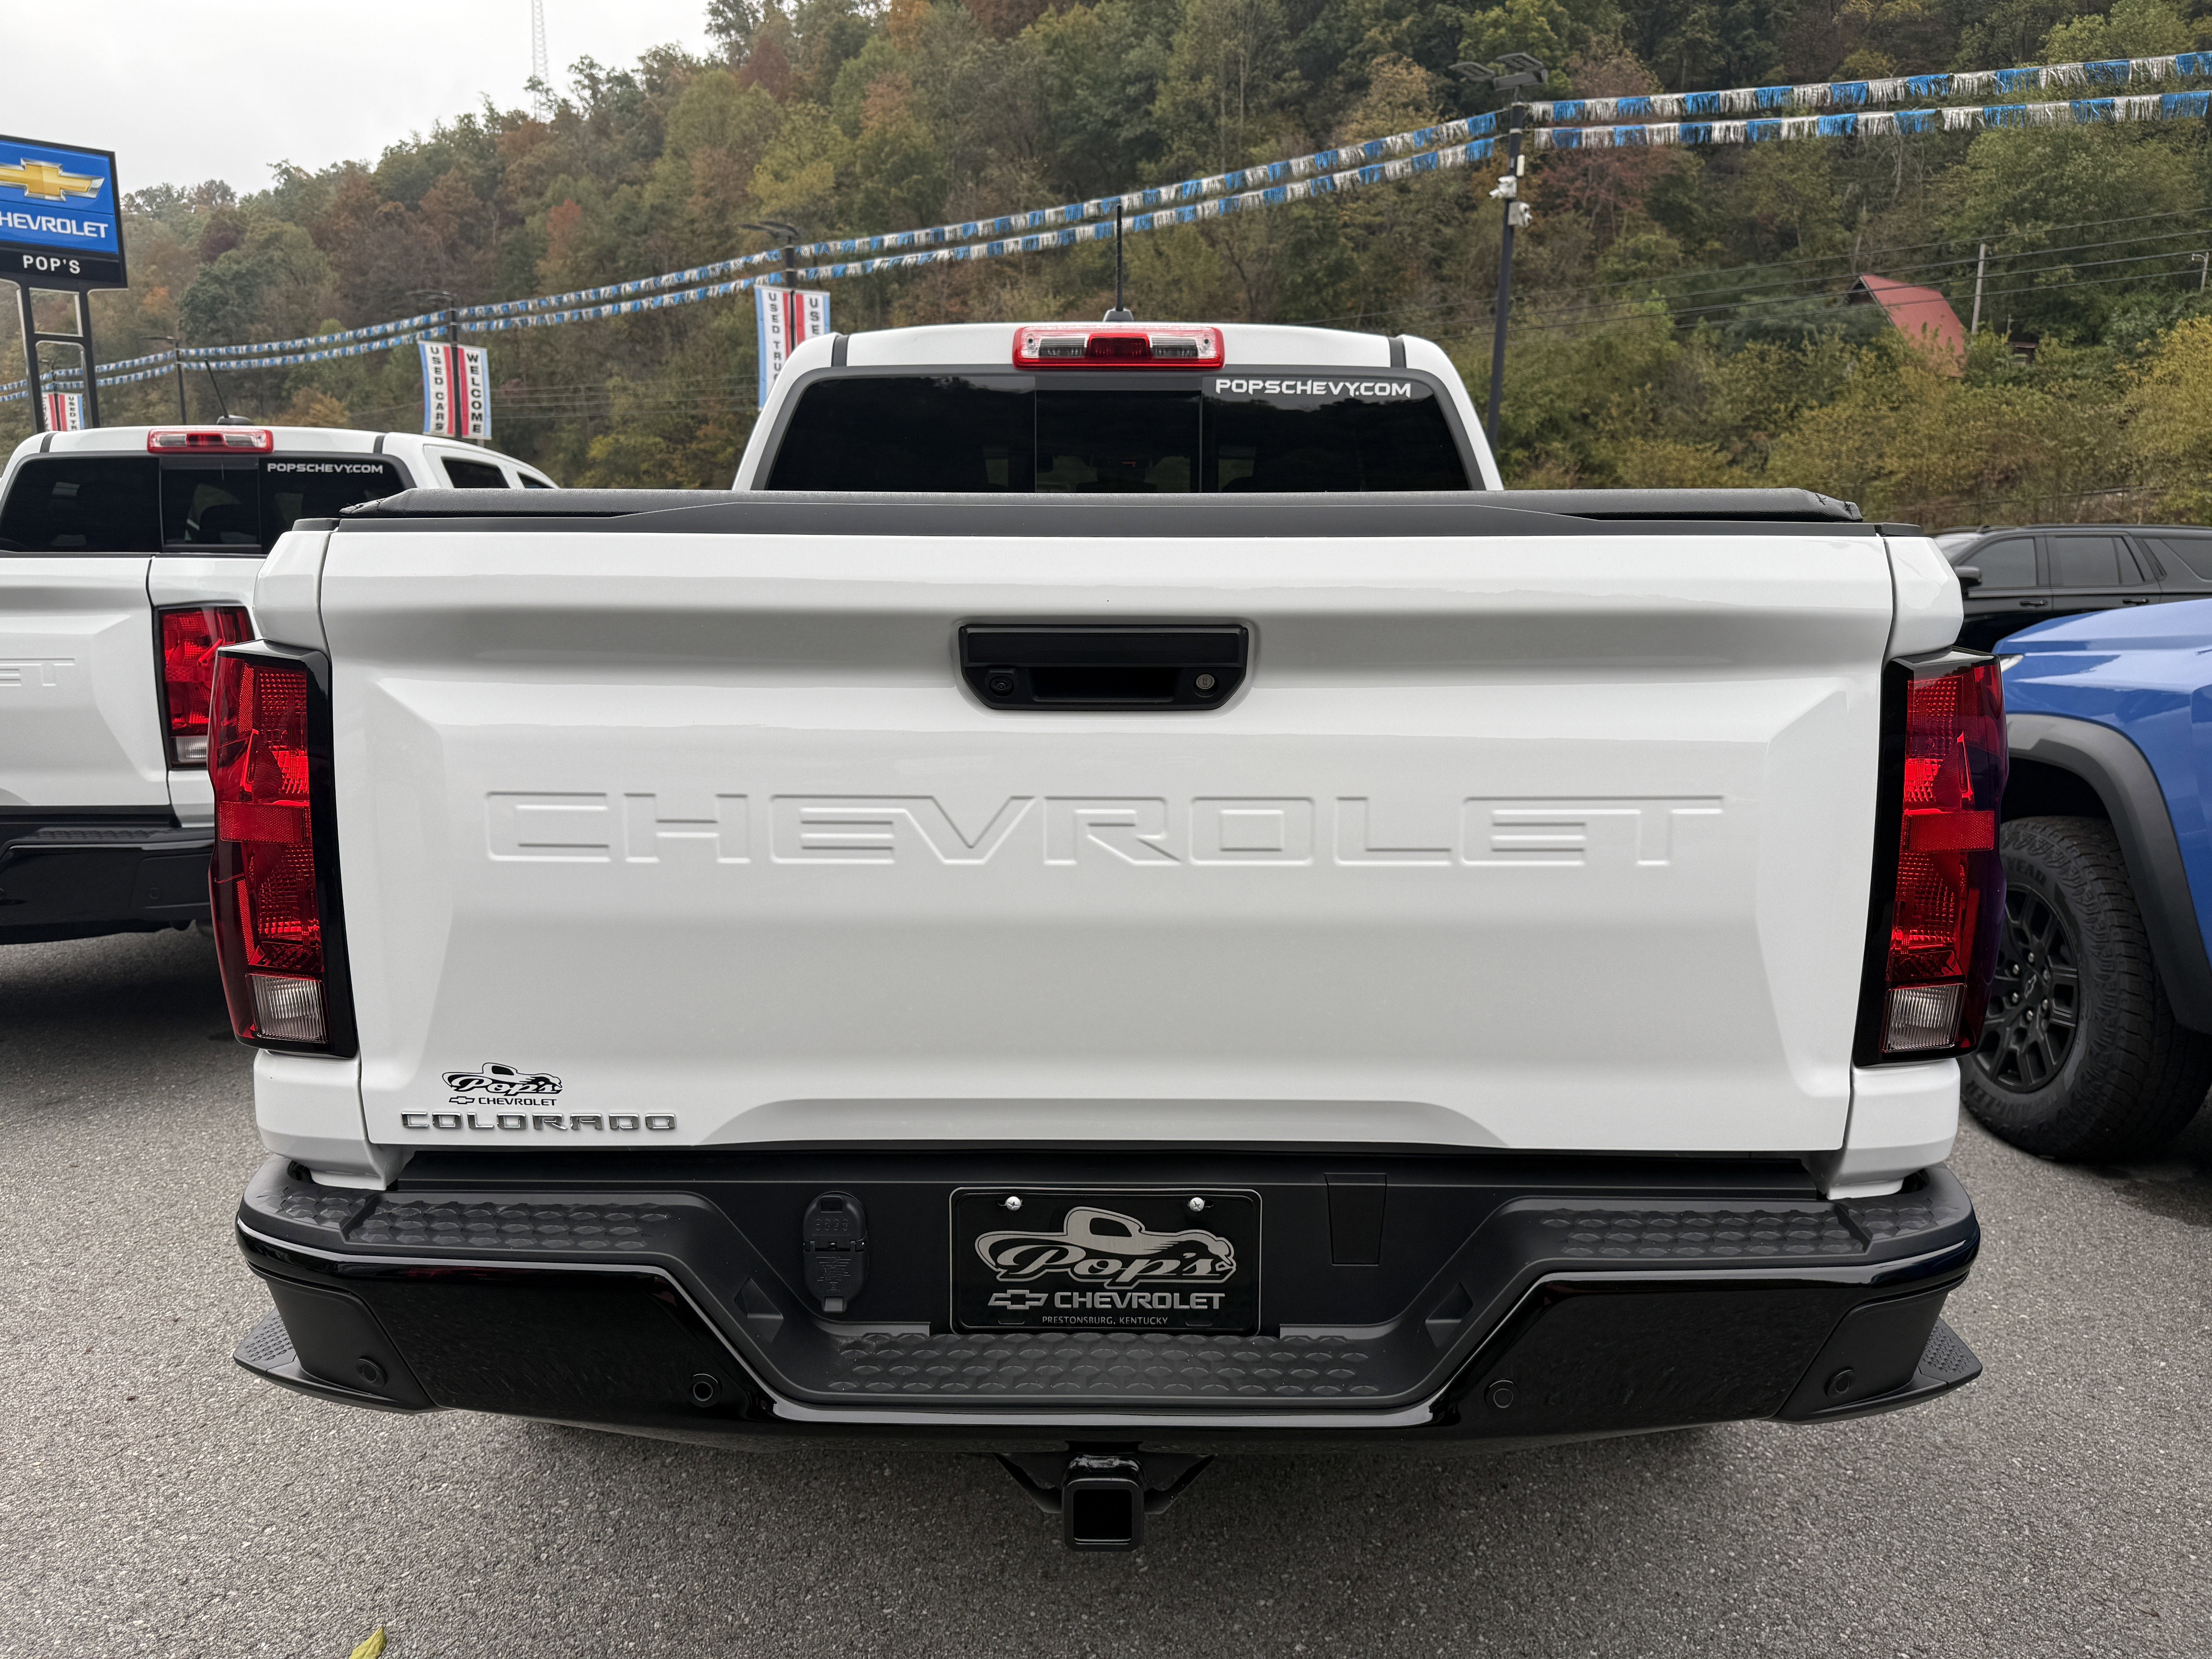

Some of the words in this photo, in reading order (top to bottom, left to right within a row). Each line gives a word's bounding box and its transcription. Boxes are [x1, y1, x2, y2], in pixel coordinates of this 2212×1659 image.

[0, 211, 108, 238] HEVROLET
[23, 255, 81, 274] POP'S
[768, 293, 780, 333] USED
[809, 297, 820, 335] USE
[430, 346, 443, 385] USED
[467, 354, 483, 433] WELCOME
[1216, 379, 1411, 398] POPSCHEVY.COM
[435, 392, 444, 431] CARS
[267, 463, 383, 474] POPSCHEVY.COM
[485, 791, 1725, 866] CHEVROLET
[478, 1097, 557, 1106] CHEVROLET
[401, 1111, 677, 1130] COLORADO
[996, 1245, 1220, 1282] Pop's
[1054, 1292, 1225, 1309] CHEVROLET
[1042, 1316, 1116, 1324] PRESTONSBURG,
